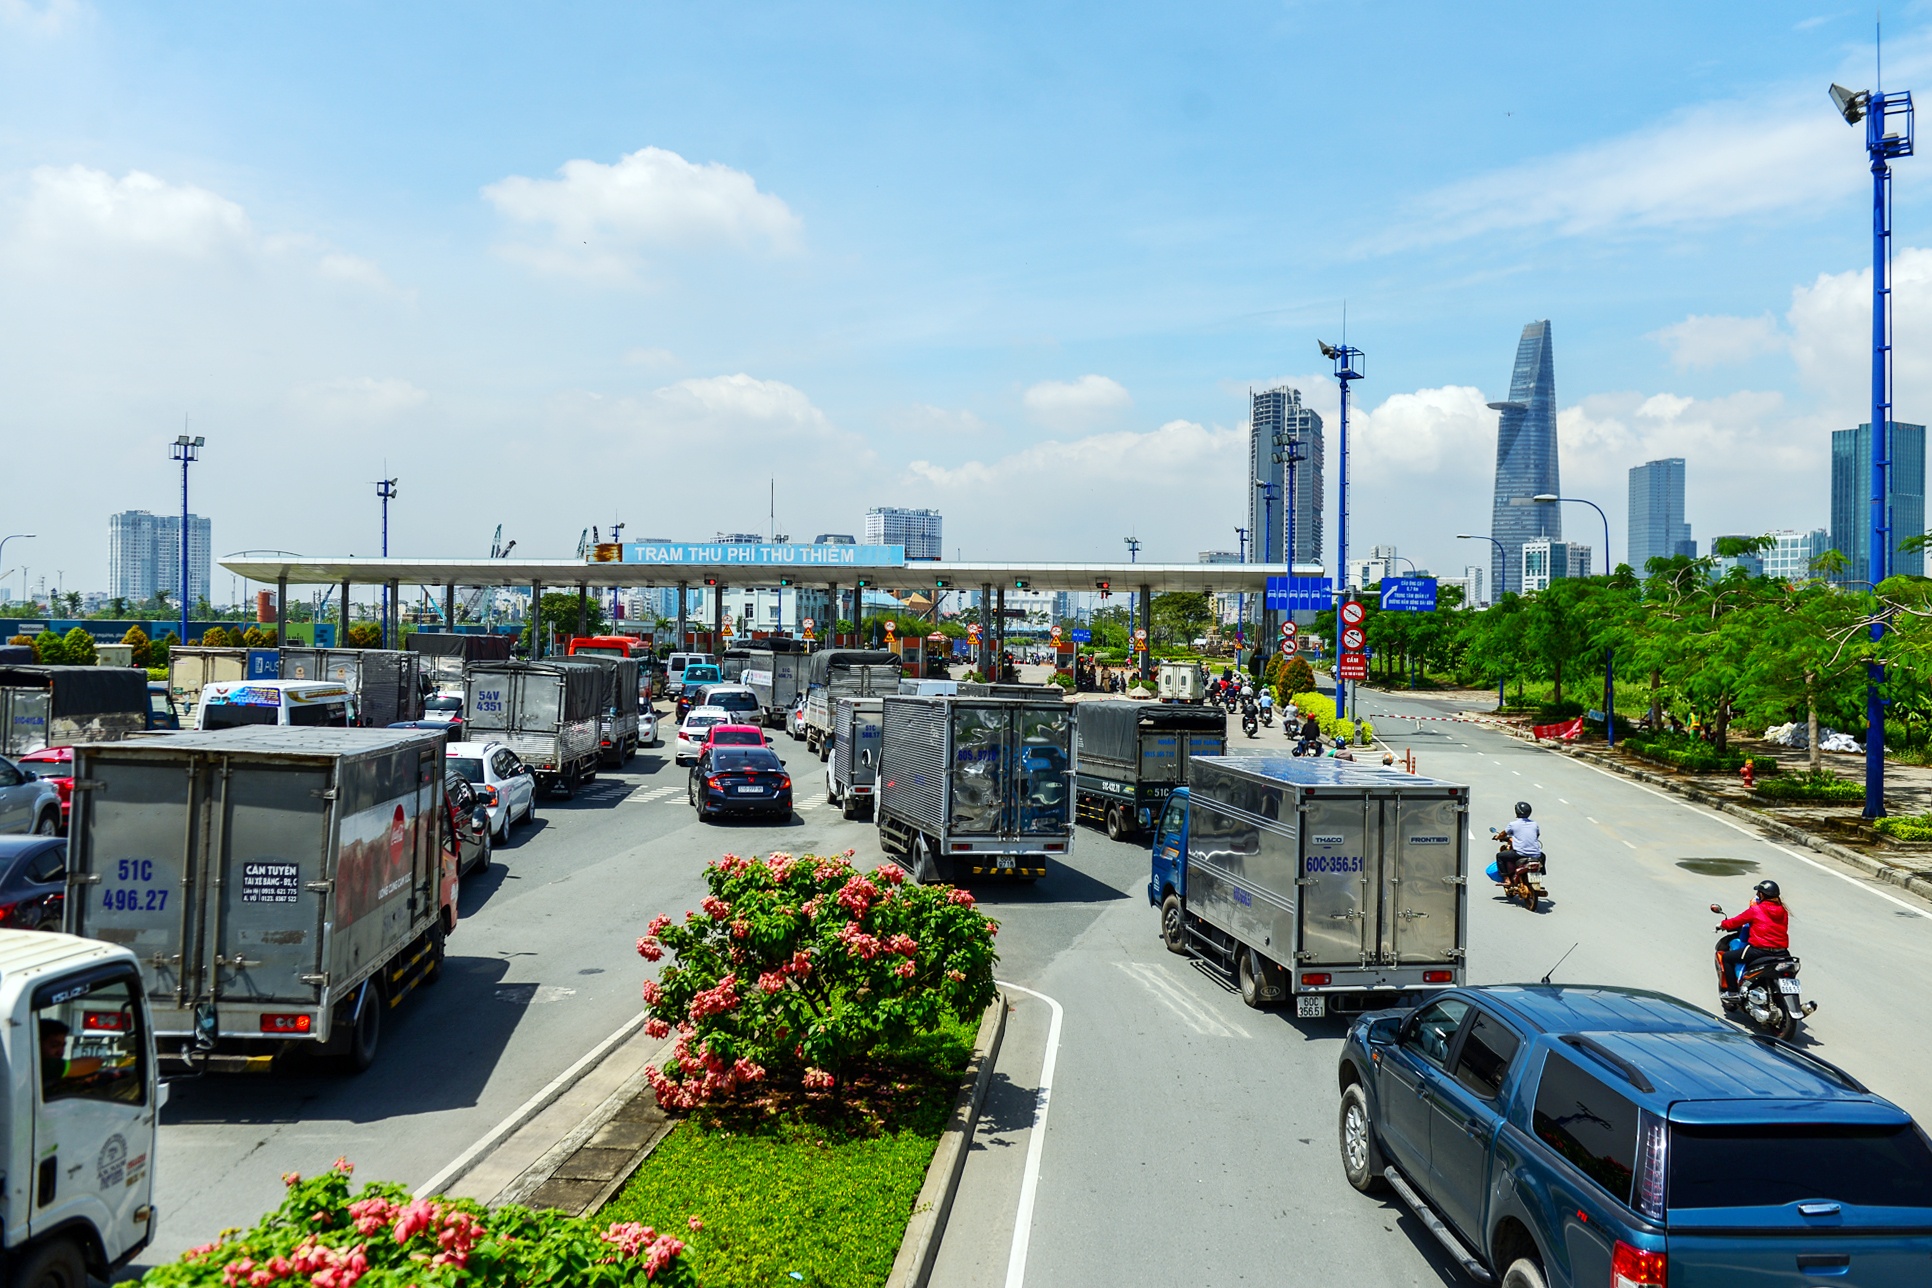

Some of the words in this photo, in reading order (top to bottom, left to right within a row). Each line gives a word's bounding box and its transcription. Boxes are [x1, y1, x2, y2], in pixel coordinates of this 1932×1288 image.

[634, 546, 683, 564] TRẠM
[687, 546, 722, 562] THU
[727, 544, 756, 562] PHÍ
[760, 543, 795, 562] THỦ
[799, 545, 855, 563] THIÊM
[479, 690, 500, 701] 54V
[476, 701, 502, 711] 4351
[1154, 788, 1170, 797] 51C
[118, 859, 153, 881] 51C
[102, 888, 169, 911] 496.27
[52, 983, 90, 1004] ISUZU
[1303, 996, 1319, 1007] 60C
